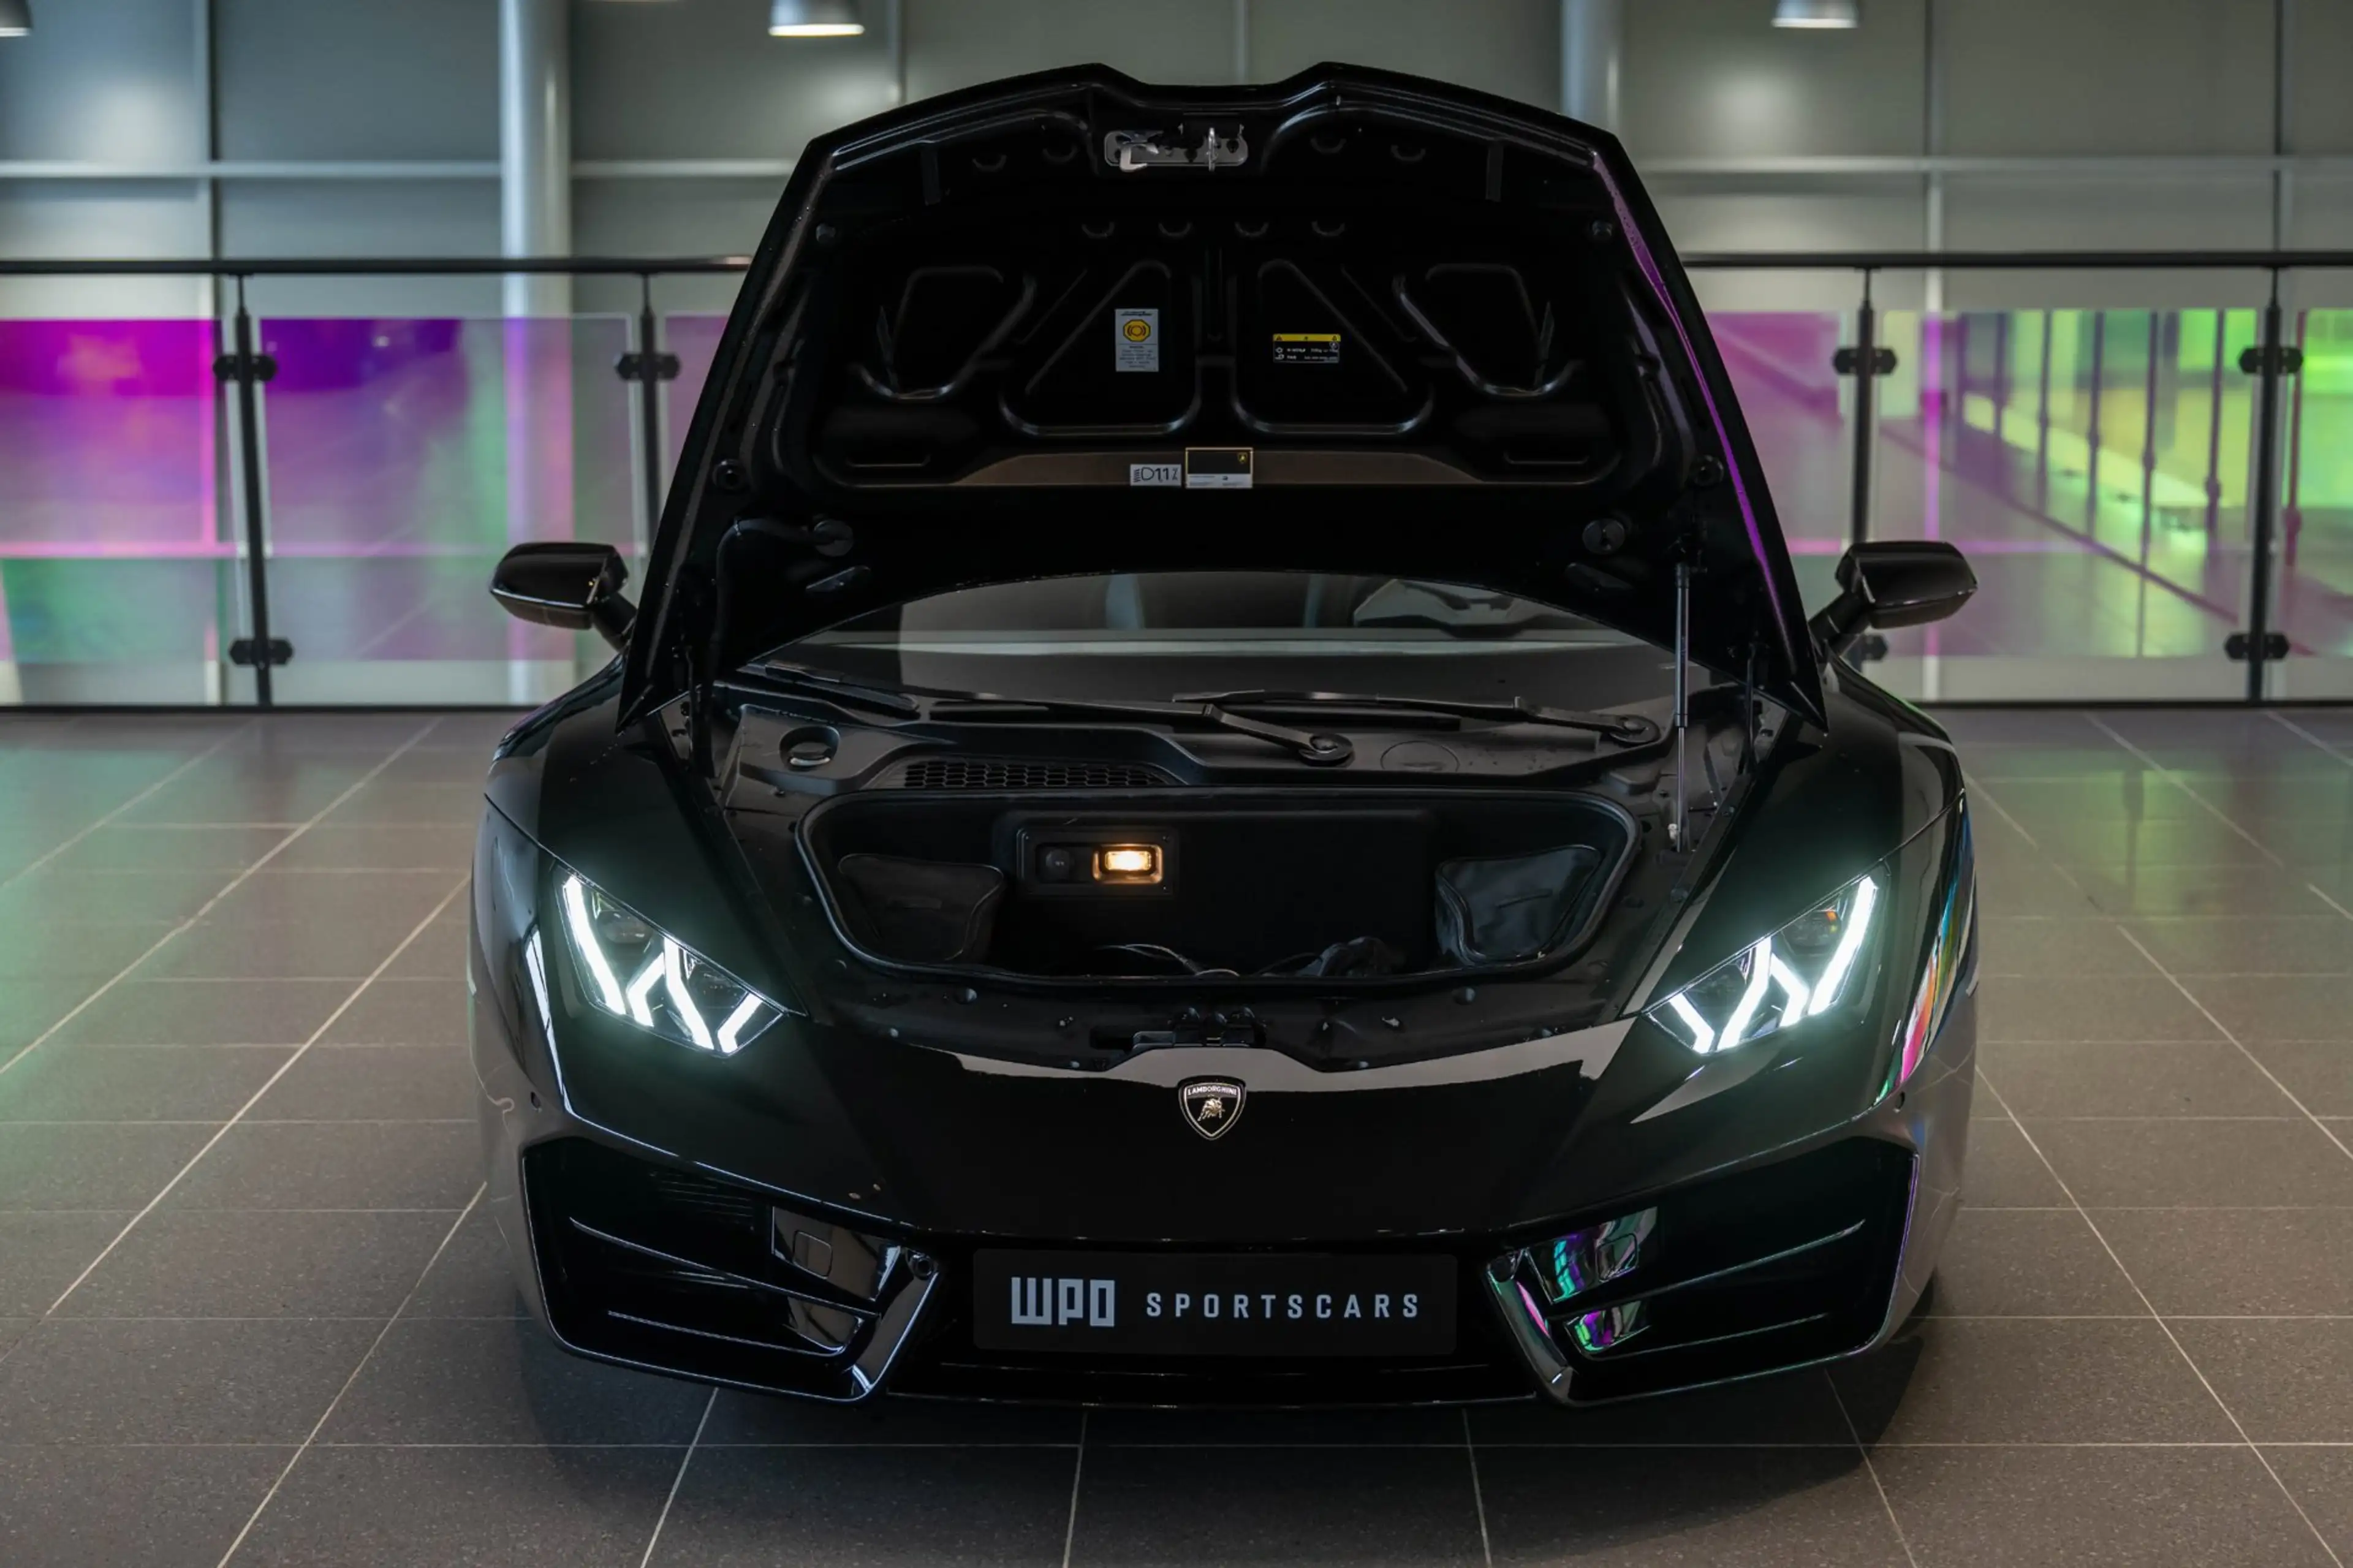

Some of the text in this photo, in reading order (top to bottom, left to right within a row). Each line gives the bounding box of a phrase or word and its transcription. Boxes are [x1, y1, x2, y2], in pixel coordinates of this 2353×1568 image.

[1188, 1086, 1237, 1096] LAMBORGHINI
[1011, 1277, 1417, 1327] WPO SPORTSCARS
